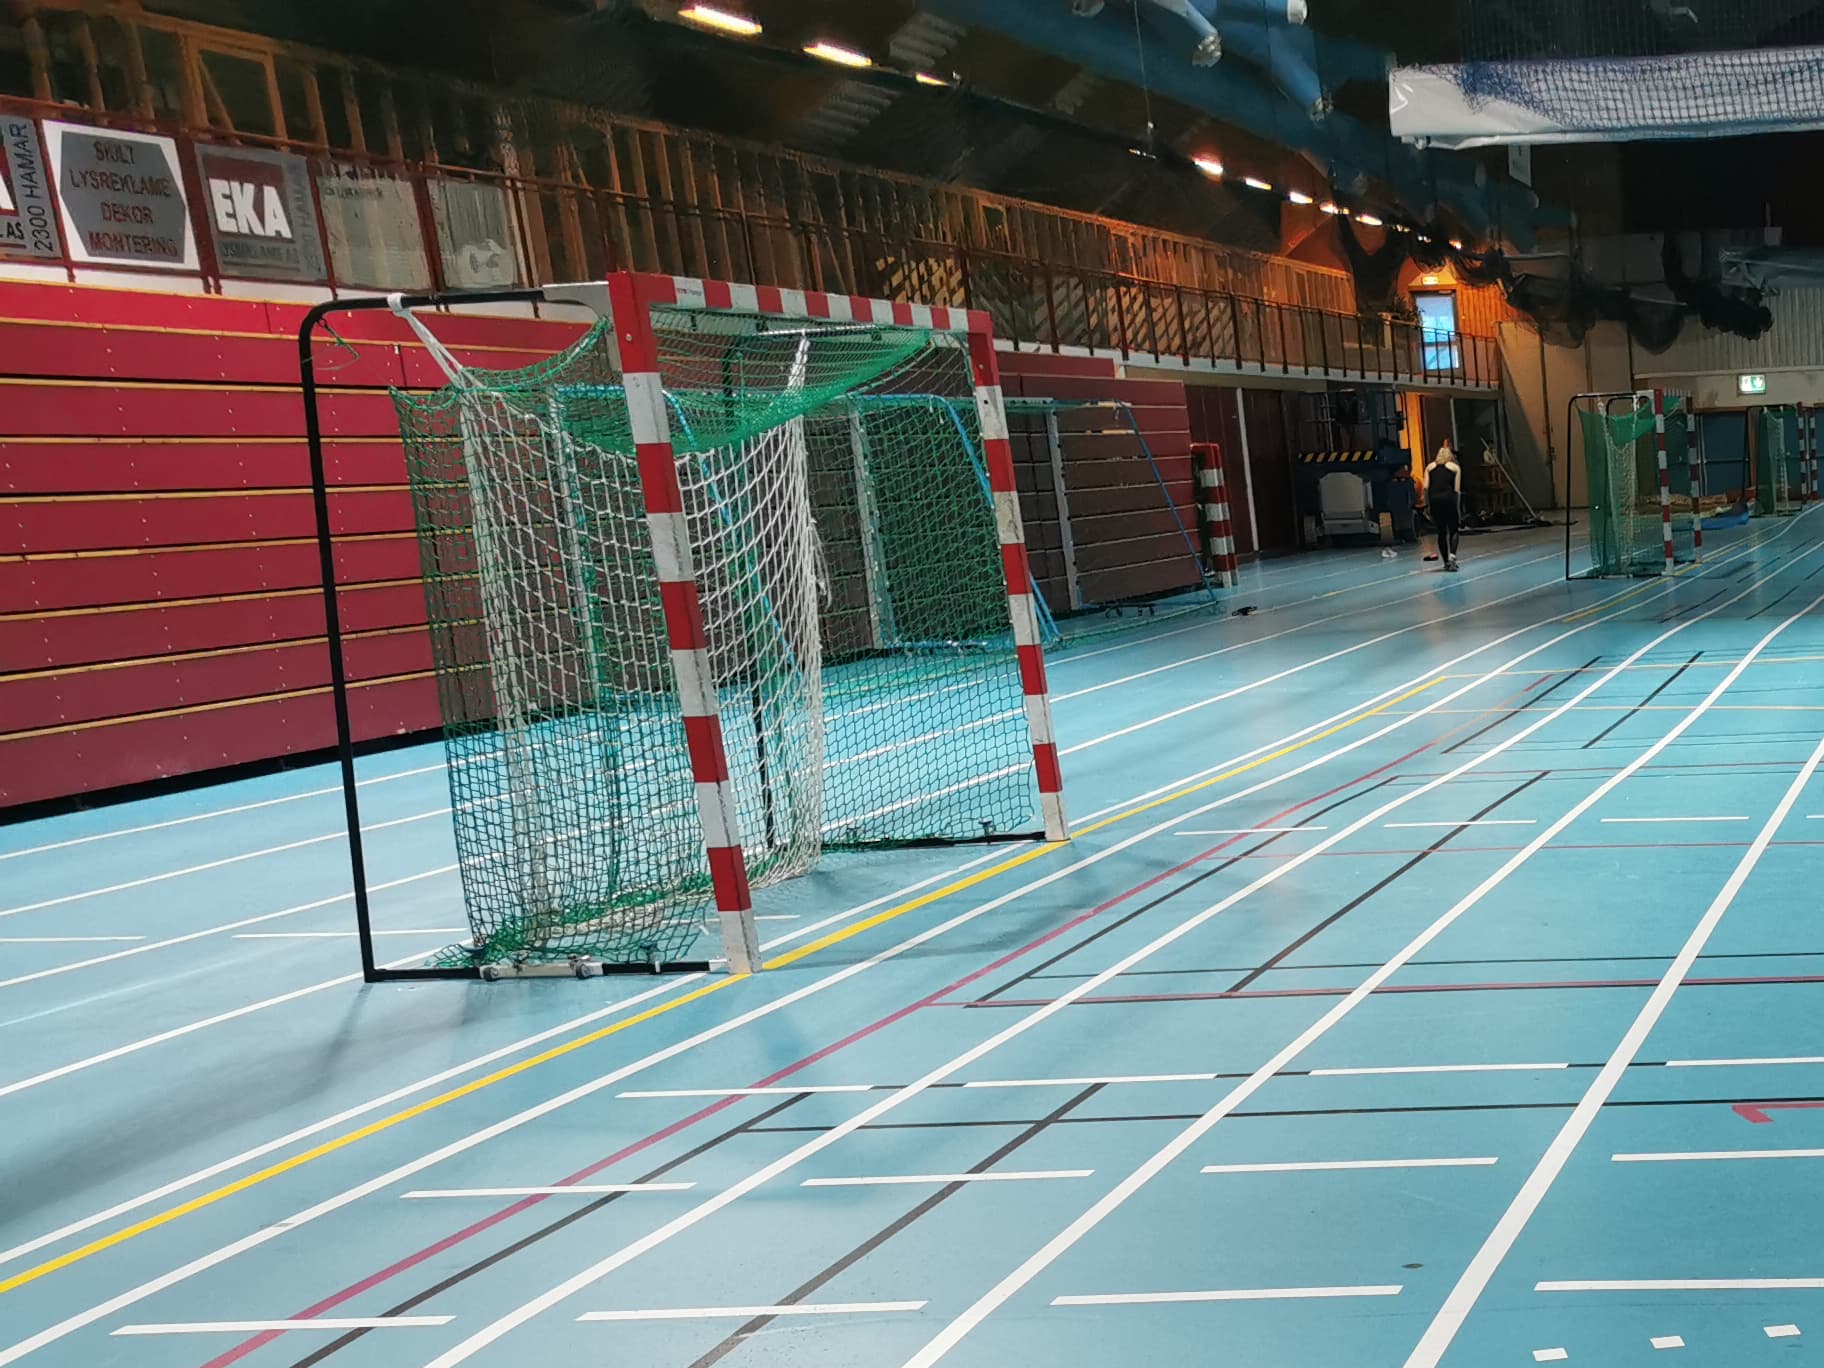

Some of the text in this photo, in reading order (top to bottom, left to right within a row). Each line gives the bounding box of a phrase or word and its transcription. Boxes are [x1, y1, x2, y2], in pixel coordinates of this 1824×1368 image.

[9, 123, 54, 252] 2300 HAMAR
[69, 169, 171, 198] LYSREKLAME
[101, 201, 154, 225] DEKOR
[208, 177, 293, 239] EKA
[6, 221, 24, 240] AS
[88, 230, 178, 257] MONTERING
